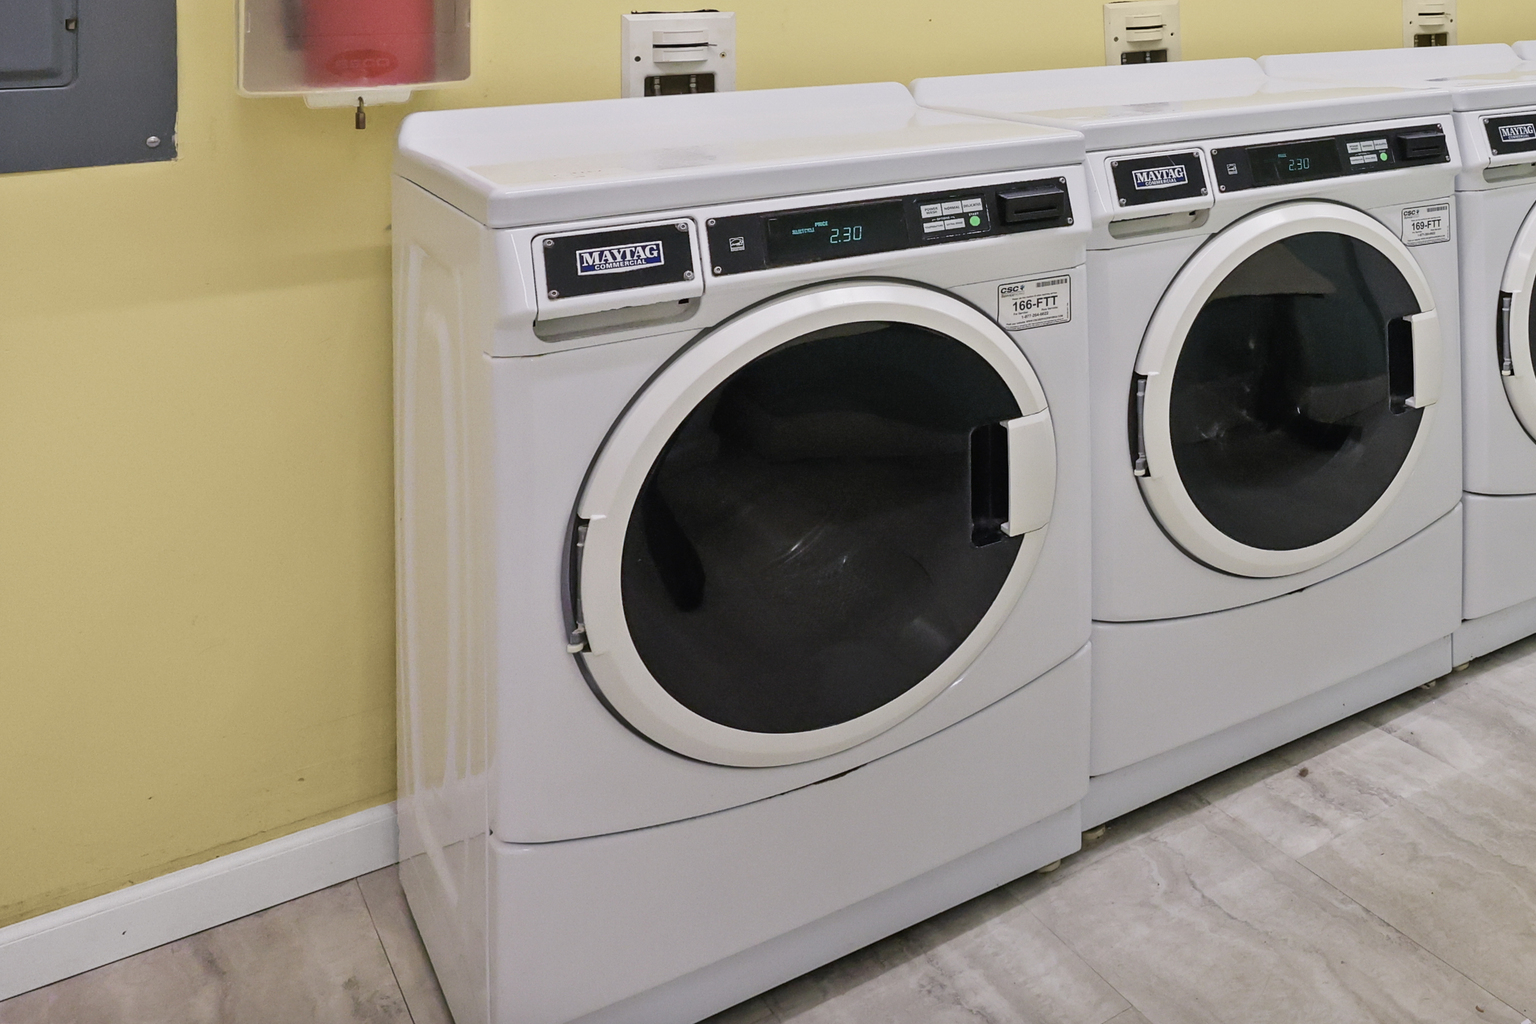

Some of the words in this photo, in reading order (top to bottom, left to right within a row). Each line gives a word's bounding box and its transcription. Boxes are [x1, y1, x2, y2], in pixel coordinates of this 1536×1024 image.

[1501, 125, 1534, 137] MAYTAG
[1288, 157, 1310, 172] 2.30
[1136, 167, 1184, 183] MAYTAG
[1411, 218, 1442, 231] 169-FTT
[829, 225, 862, 244] 2.30
[580, 244, 659, 267] MAYTAG
[594, 259, 647, 271] COMMERCIAL
[1000, 285, 1019, 294] CSC
[1012, 295, 1058, 312] 166-FTT
